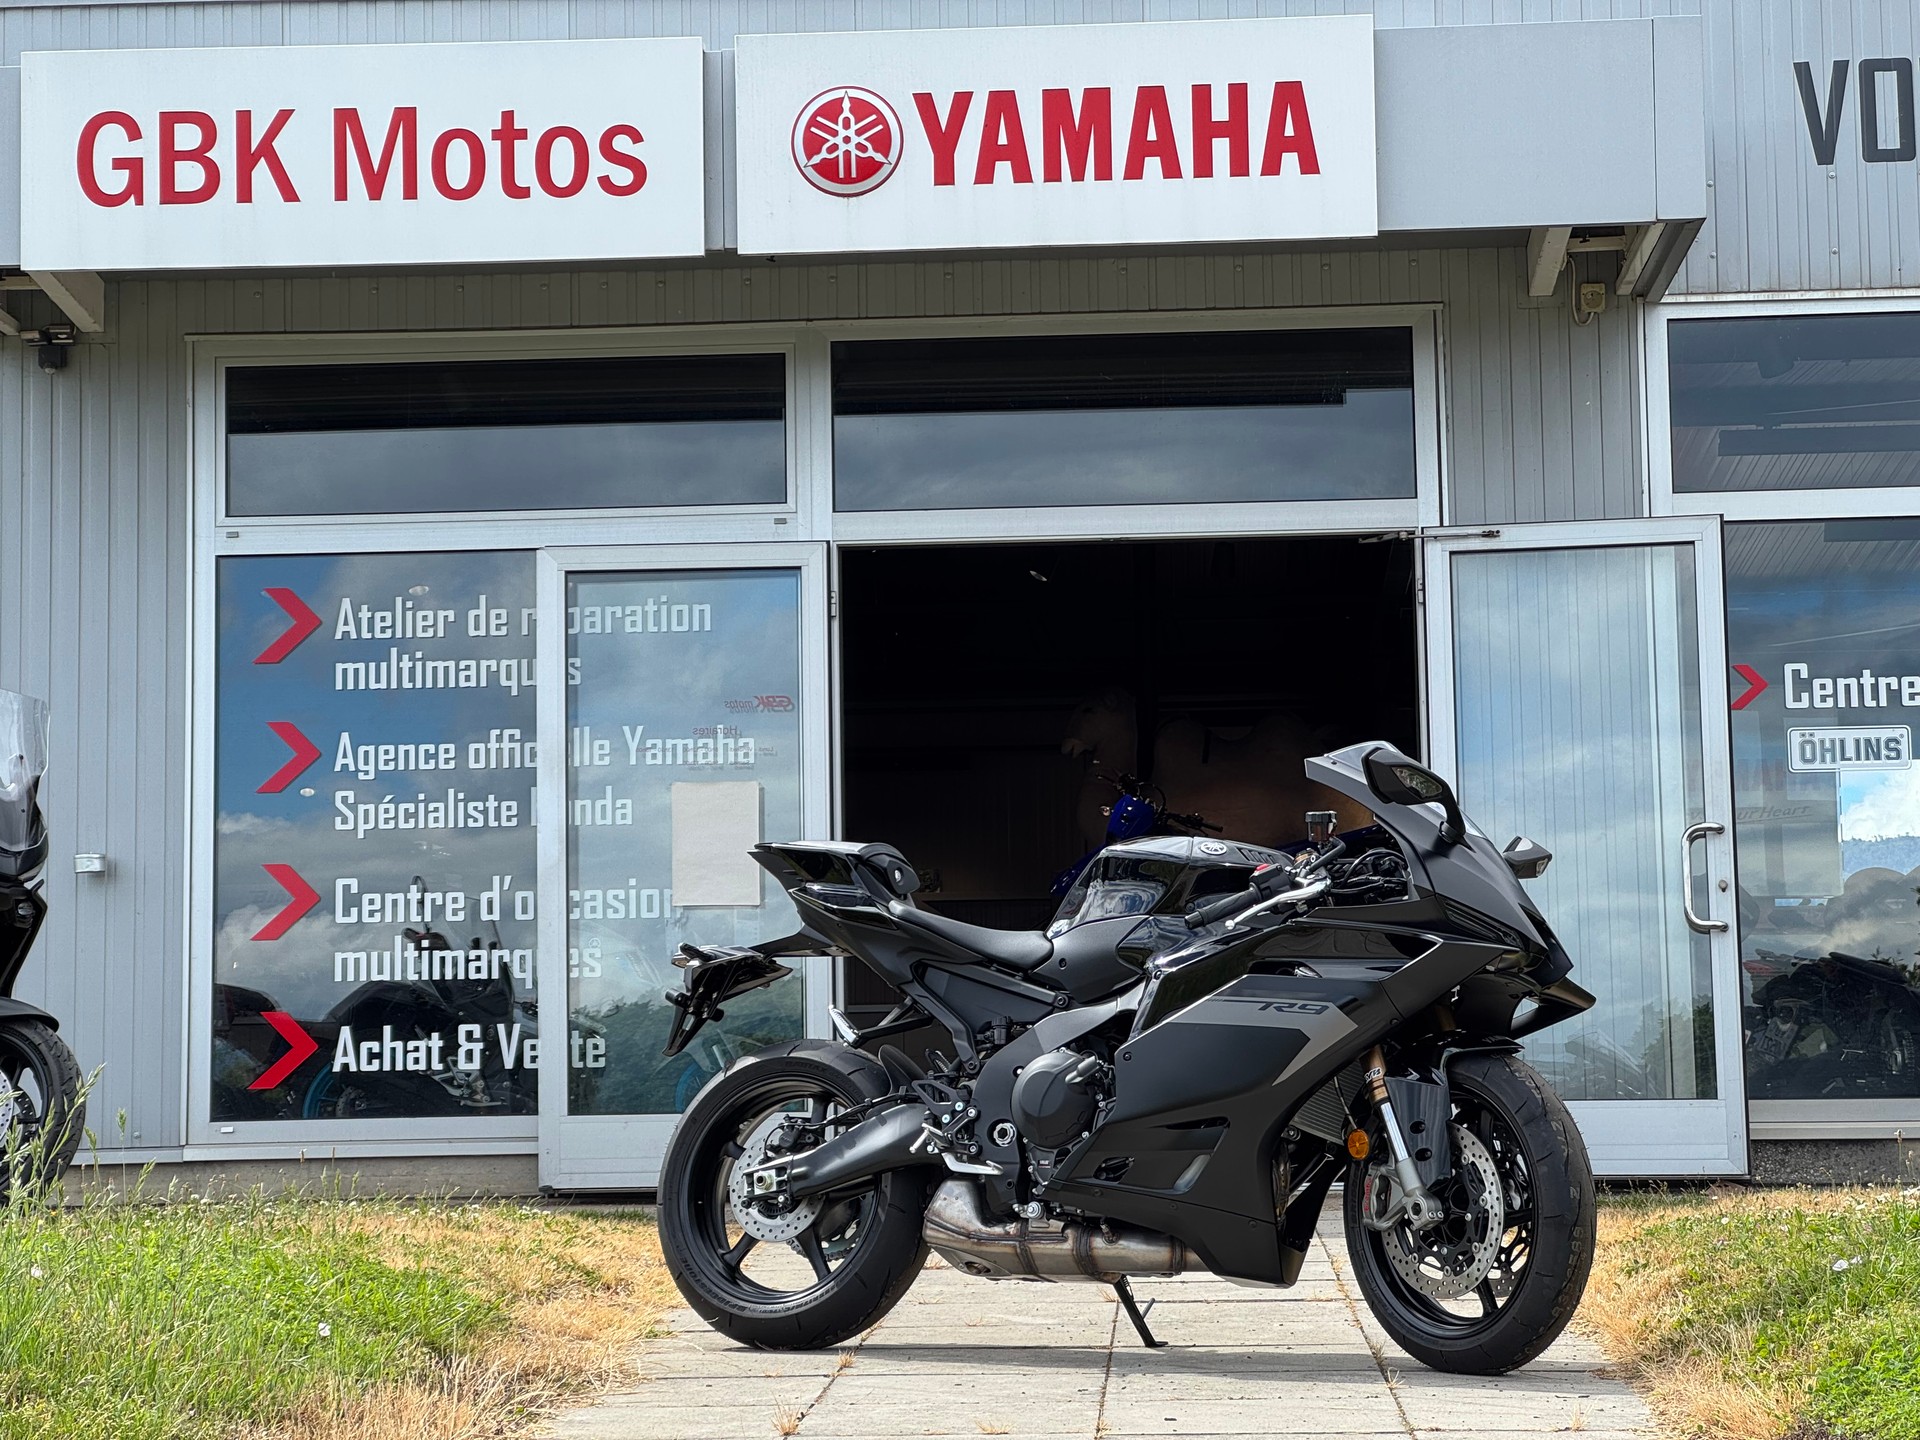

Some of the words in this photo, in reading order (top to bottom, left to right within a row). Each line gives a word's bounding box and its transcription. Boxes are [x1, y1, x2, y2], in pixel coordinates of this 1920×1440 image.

[912, 80, 1321, 187] YAMAHA
[1793, 57, 1920, 166] VO
[77, 108, 301, 208] GBK
[333, 106, 648, 202] Motos
[334, 596, 456, 640] Atelier
[467, 595, 508, 637] de
[335, 647, 582, 696] multimarqus
[1783, 662, 1920, 709] Centre
[334, 731, 456, 781] Agence
[467, 726, 610, 769] officlle
[622, 723, 756, 766] Yamaha
[1798, 732, 1903, 765] ÖHLINS
[334, 788, 519, 839] Spécialiste
[530, 785, 633, 829] nda
[335, 877, 466, 924] Centre
[480, 875, 672, 922] d'ocasio
[334, 935, 602, 990] multimarqes
[1258, 1002, 1330, 1016] R9
[332, 1025, 444, 1073] Achat
[457, 1023, 485, 1071] &
[497, 1023, 607, 1070] Vete
